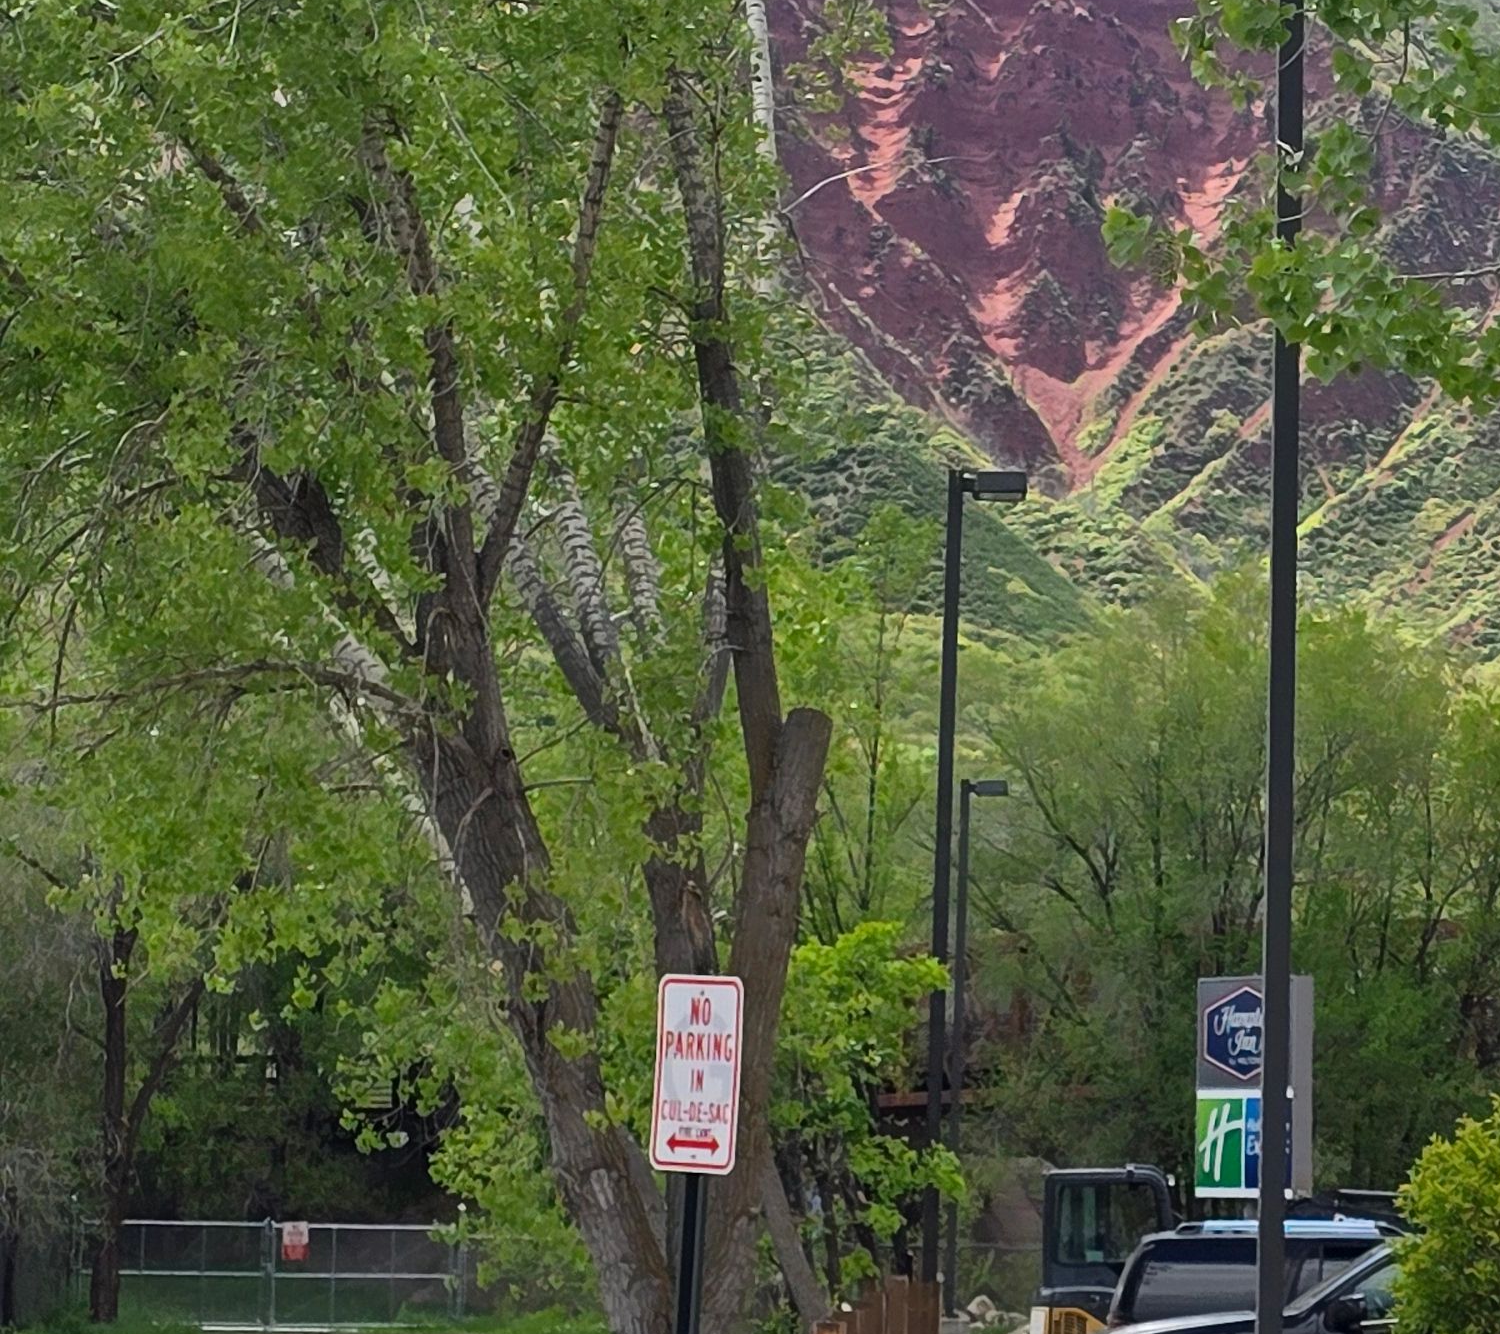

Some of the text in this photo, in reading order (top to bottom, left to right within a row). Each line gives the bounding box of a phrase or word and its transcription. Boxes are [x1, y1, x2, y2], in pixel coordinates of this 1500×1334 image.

[689, 998, 712, 1026] NO
[665, 1030, 733, 1062] PARKING
[689, 1069, 704, 1093] IN
[661, 1099, 729, 1125] CUL-DE-SAC
